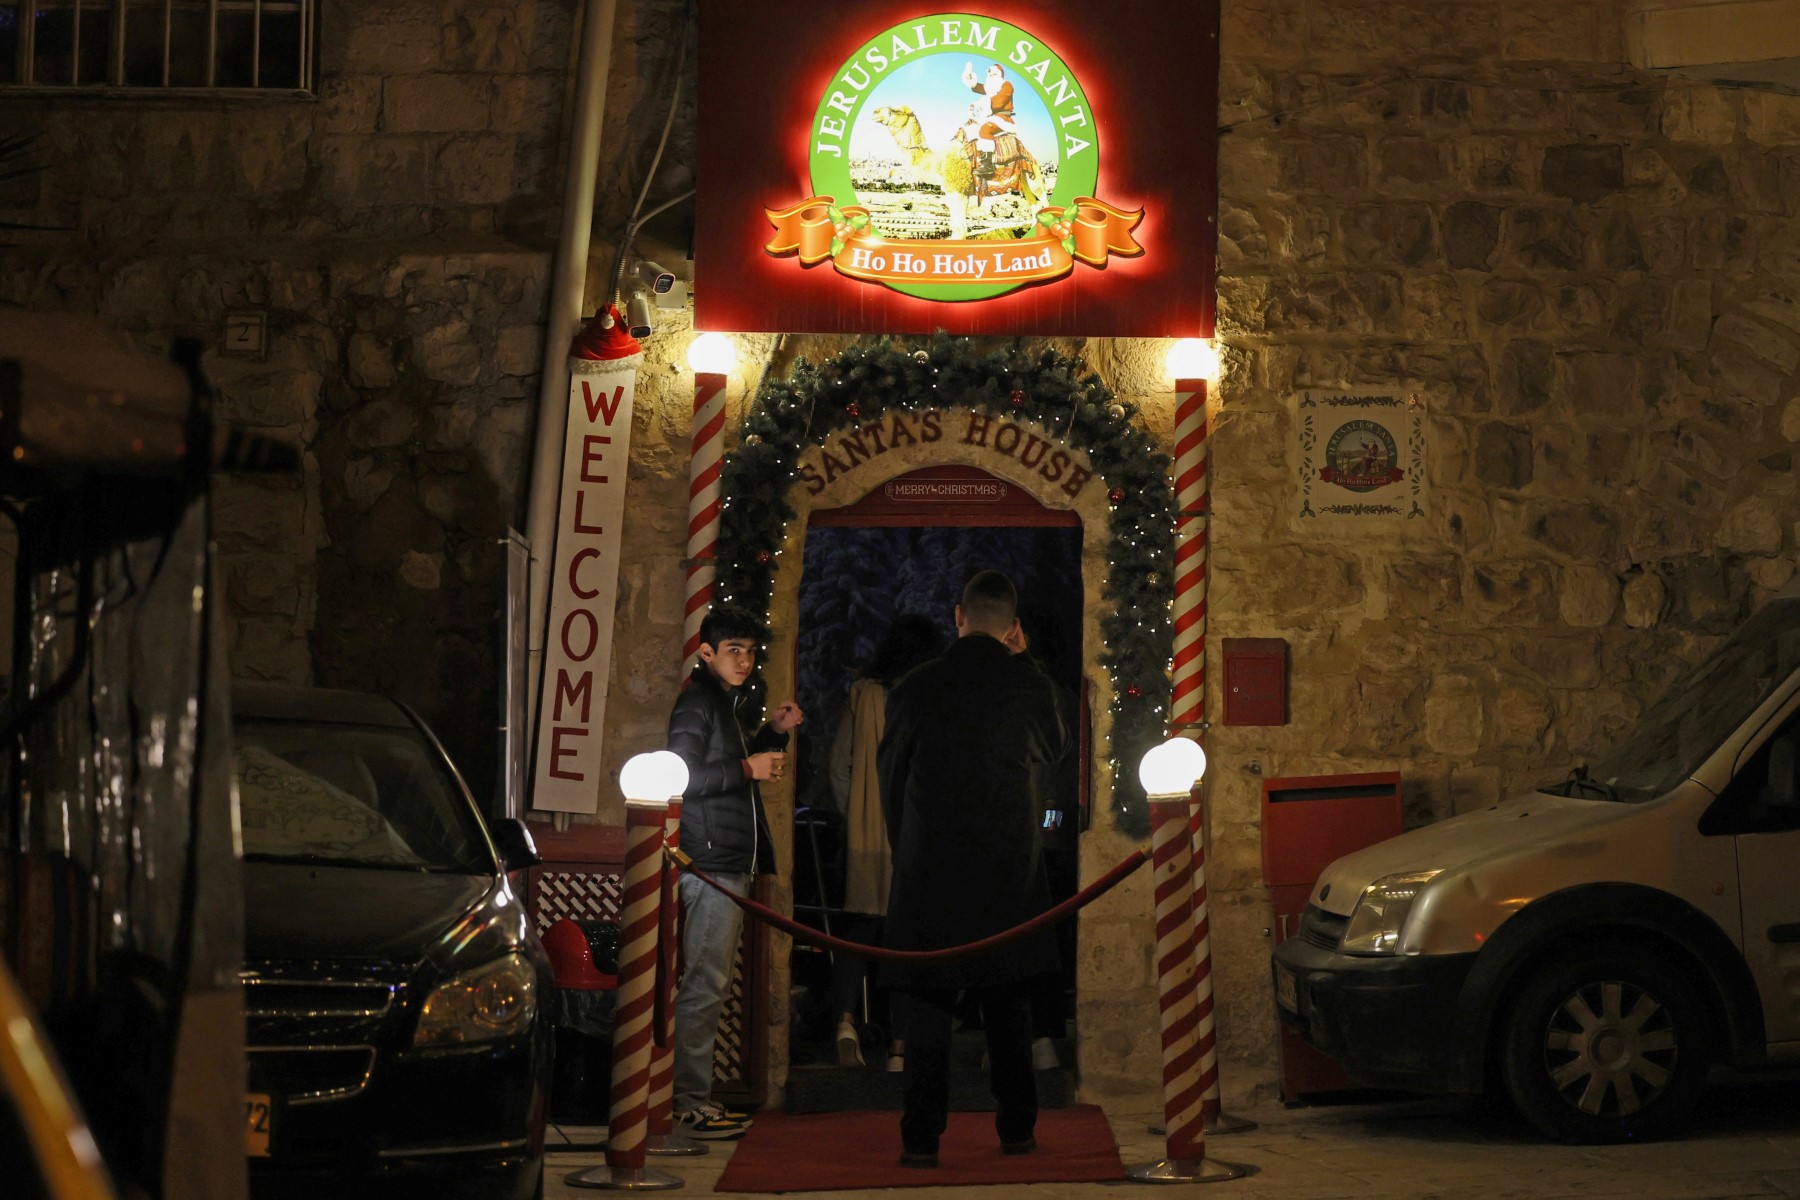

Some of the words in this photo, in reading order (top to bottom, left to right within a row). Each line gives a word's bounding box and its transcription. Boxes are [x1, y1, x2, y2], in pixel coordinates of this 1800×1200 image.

[816, 20, 1002, 159] JERUSALEM
[1008, 39, 1092, 160] SANTA
[850, 247, 886, 272] Ho
[891, 251, 927, 275] Ho
[932, 253, 989, 279] Holy
[993, 247, 1054, 274] Land
[237, 321, 249, 342] 2
[798, 411, 943, 497] SANTA'S
[963, 412, 1092, 498] HOUSE
[895, 484, 931, 495] MERRY
[938, 484, 997, 495] CHRISTMAS
[549, 381, 625, 782] WELCOME
